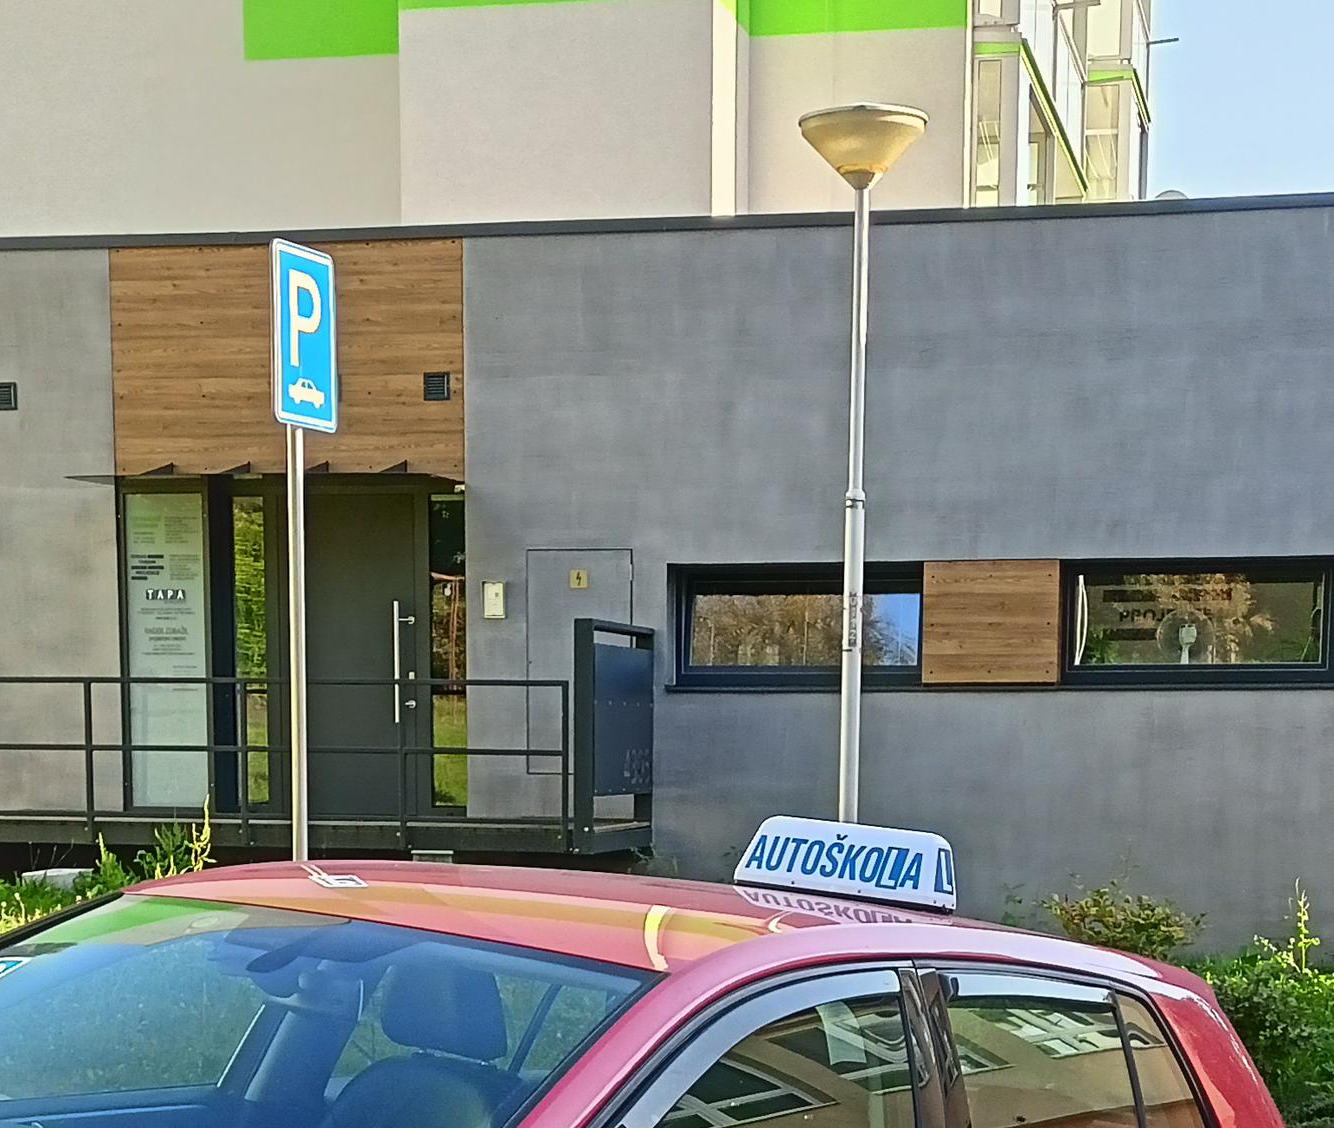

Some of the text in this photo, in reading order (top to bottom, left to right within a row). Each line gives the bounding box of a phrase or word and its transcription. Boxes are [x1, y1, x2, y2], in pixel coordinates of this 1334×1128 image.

[289, 268, 321, 368] P
[147, 589, 185, 600] TAPA
[745, 834, 923, 890] AUTOŠKOLA
